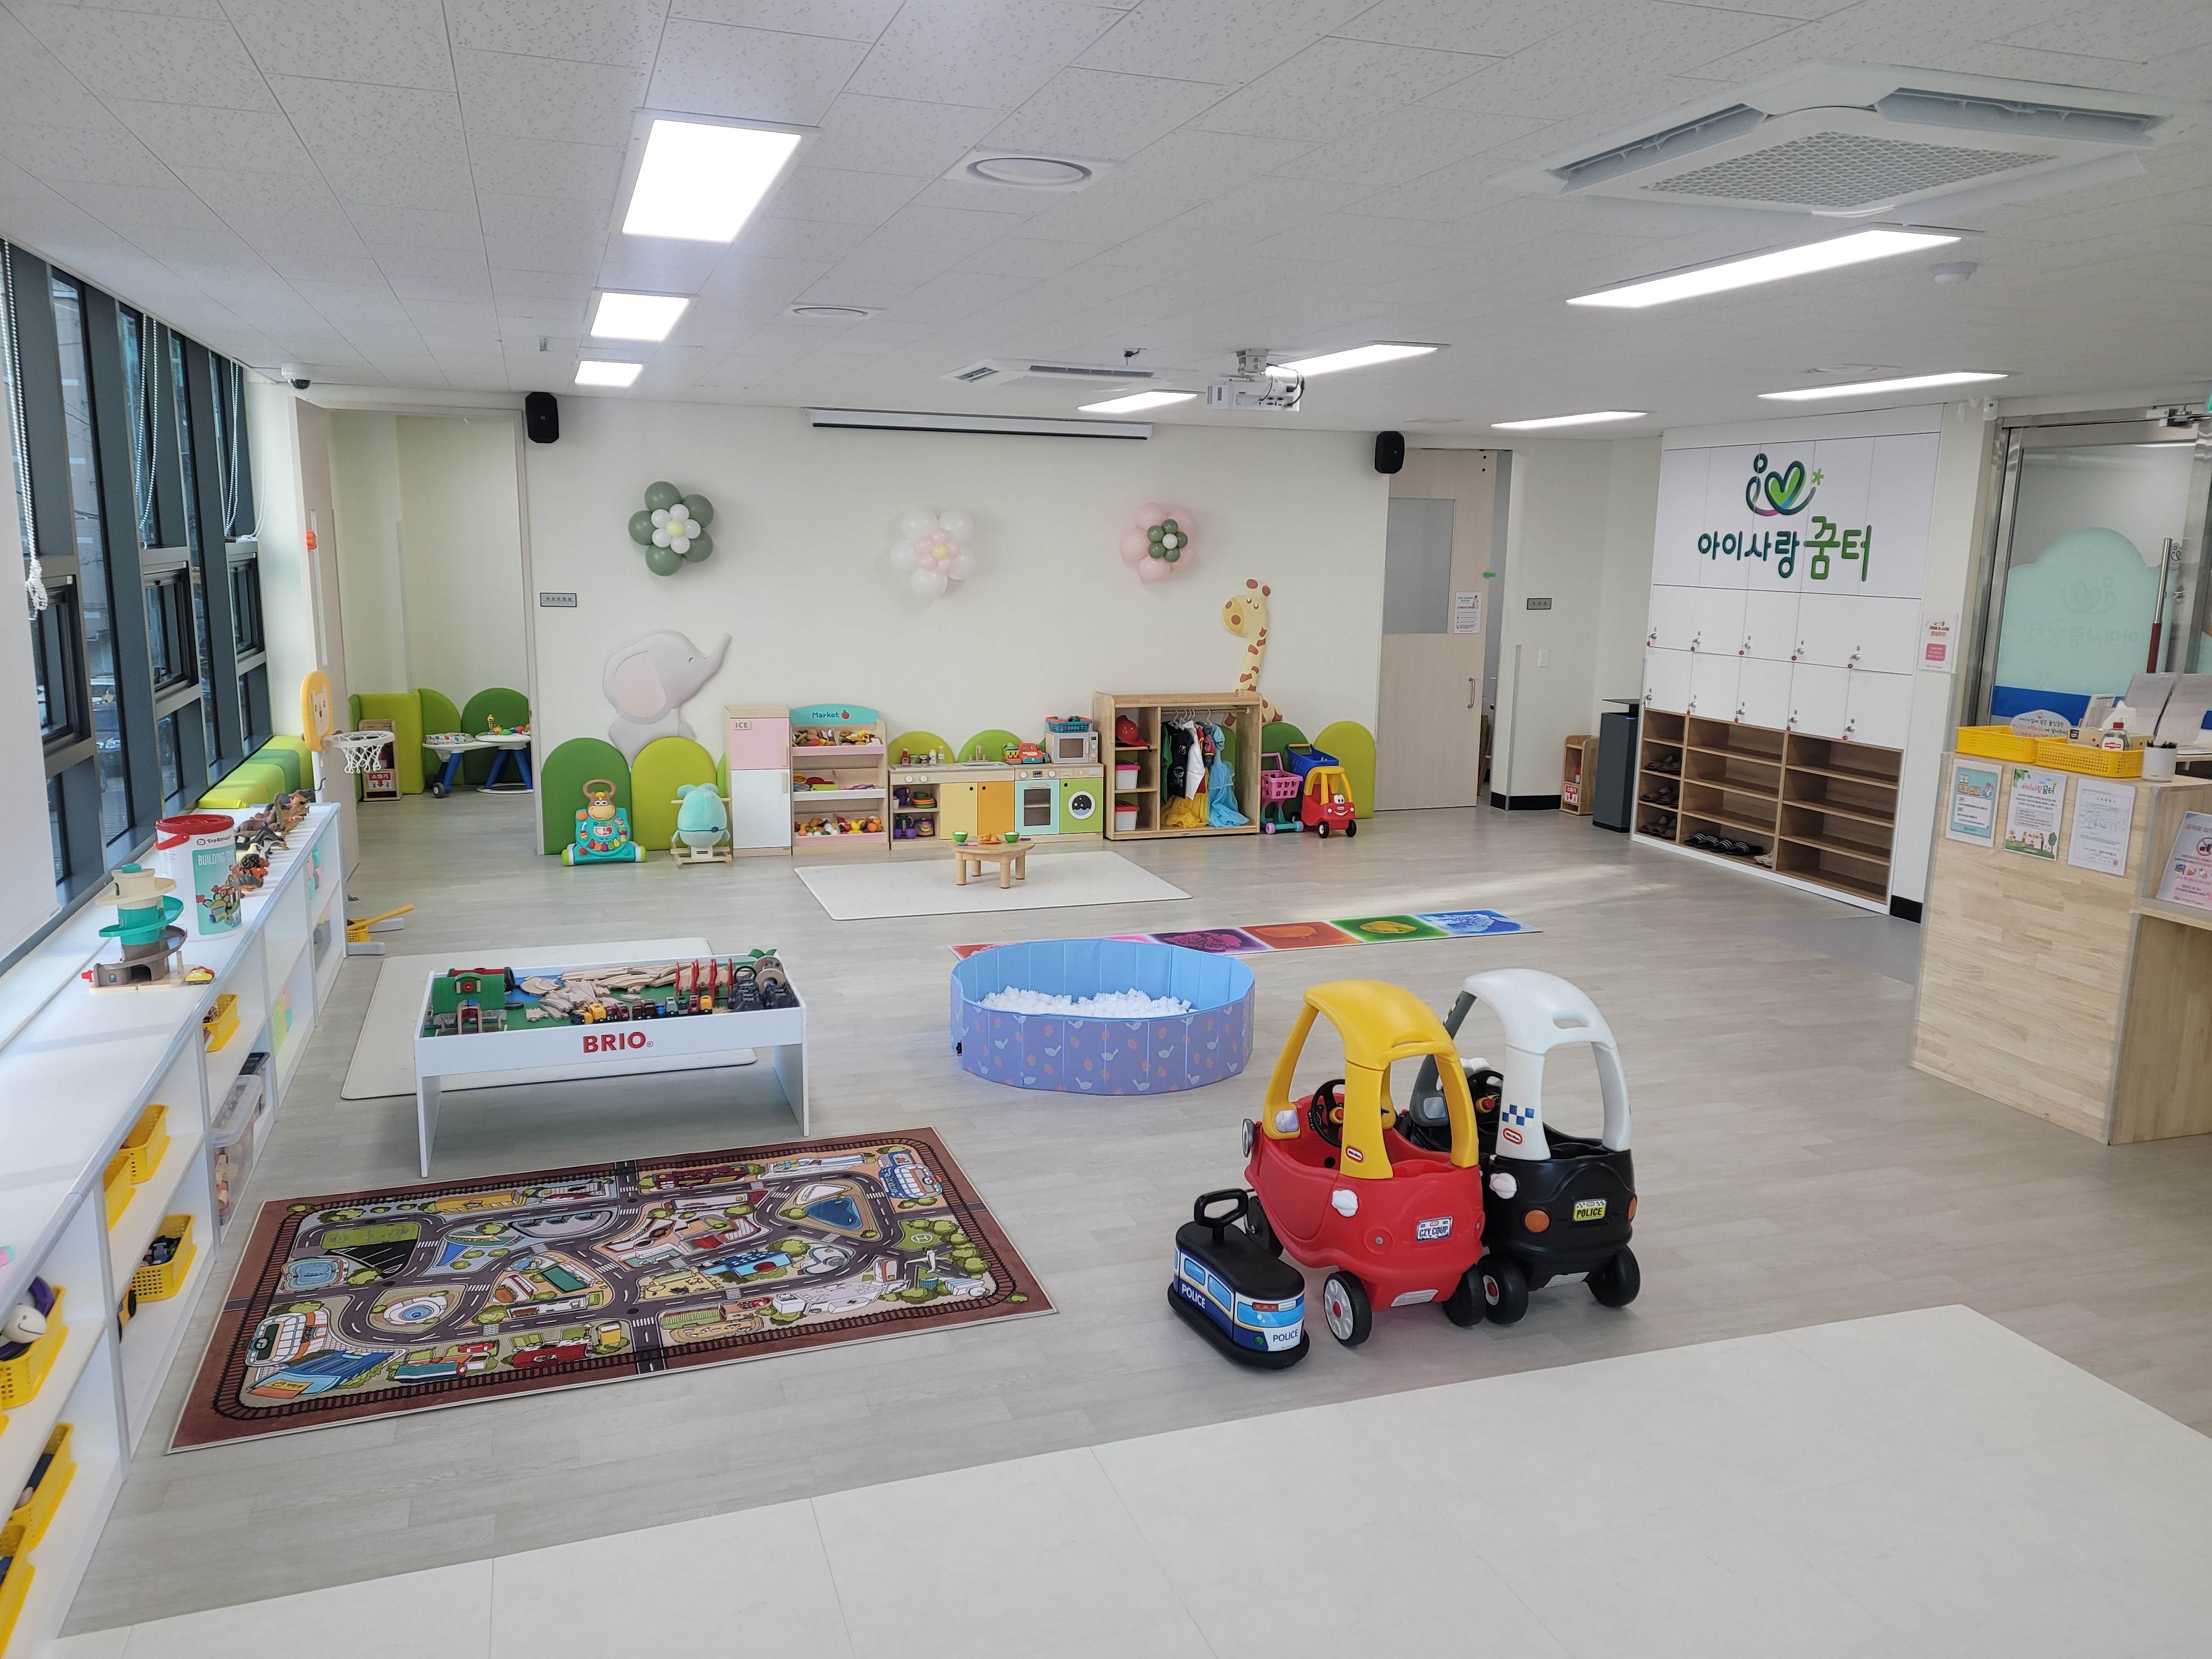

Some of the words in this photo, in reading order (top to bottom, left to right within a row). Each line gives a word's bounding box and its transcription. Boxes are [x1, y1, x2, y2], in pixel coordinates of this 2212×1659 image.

[1697, 515, 1872, 582] 아이사랑꿈터
[811, 710, 839, 720] Market
[2021, 783, 2056, 795] 아이사랑꿈터
[198, 850, 225, 866] BUILDING
[1576, 1207, 1603, 1218] POLICE
[1419, 1227, 1432, 1238] CZY
[1432, 1225, 1448, 1235] COUP
[1182, 1283, 1206, 1310] POLICE
[1273, 1329, 1299, 1342] POLICE
